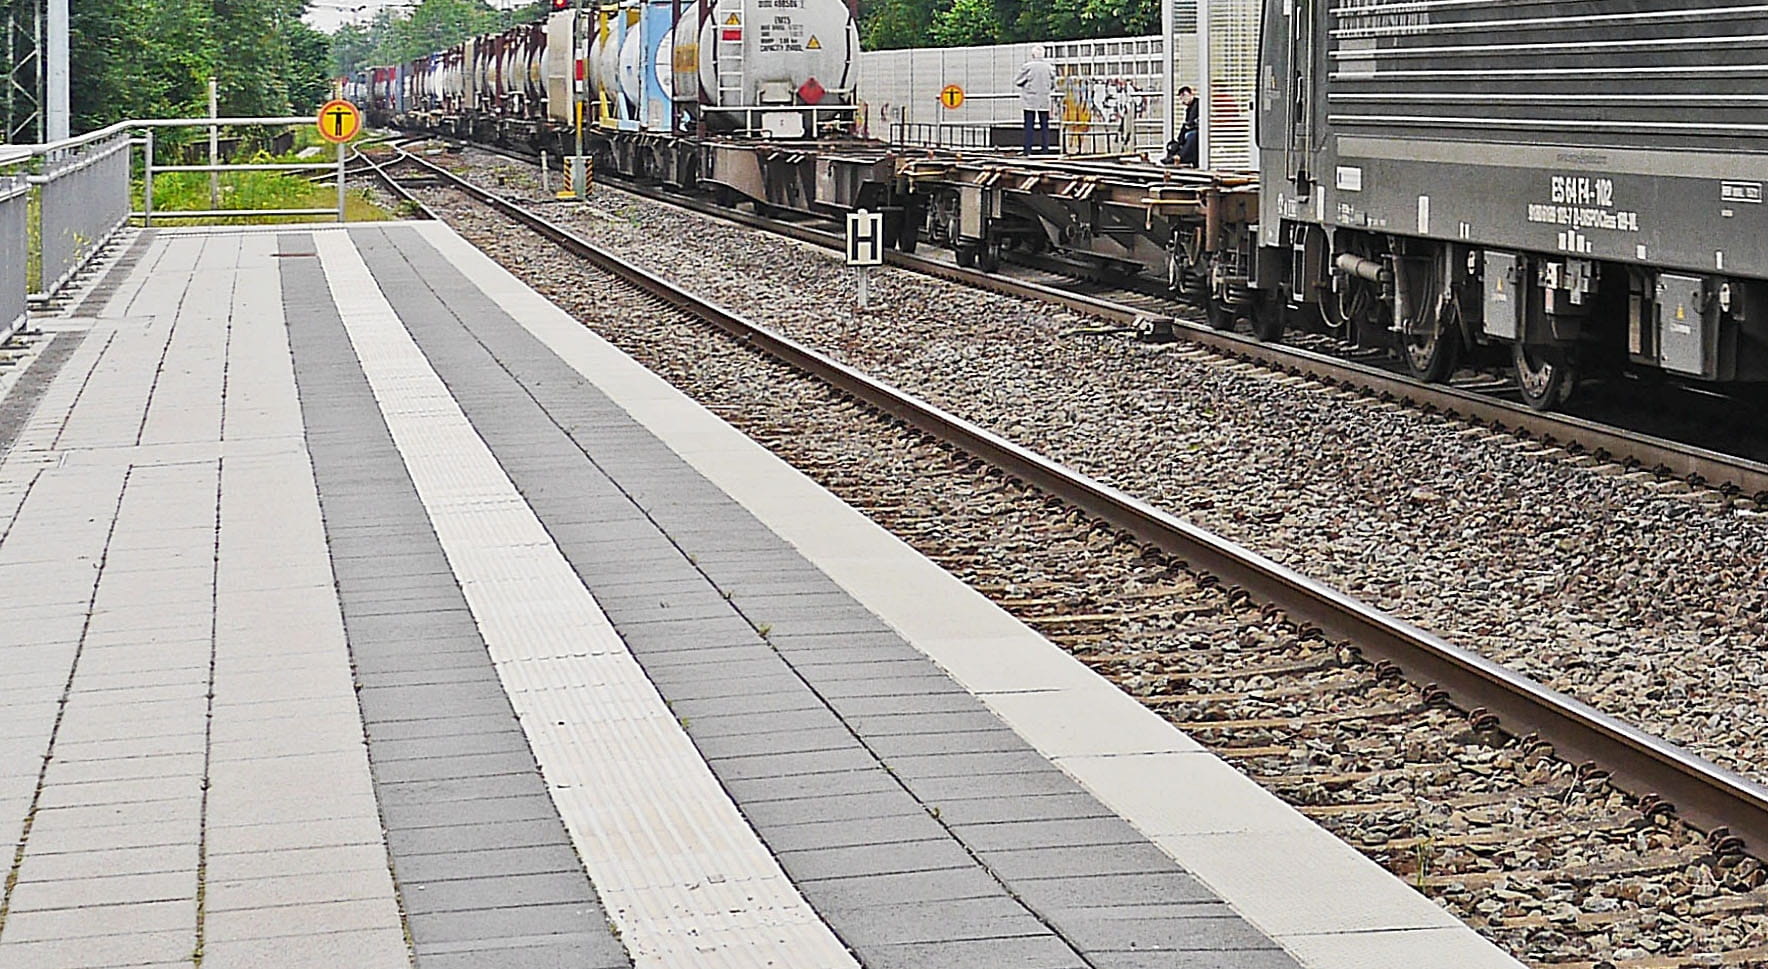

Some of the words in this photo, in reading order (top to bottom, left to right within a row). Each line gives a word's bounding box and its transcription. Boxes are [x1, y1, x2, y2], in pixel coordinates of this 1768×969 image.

[1551, 175, 1565, 203] ES
[1565, 176, 1577, 204] 64
[851, 218, 878, 261] H
